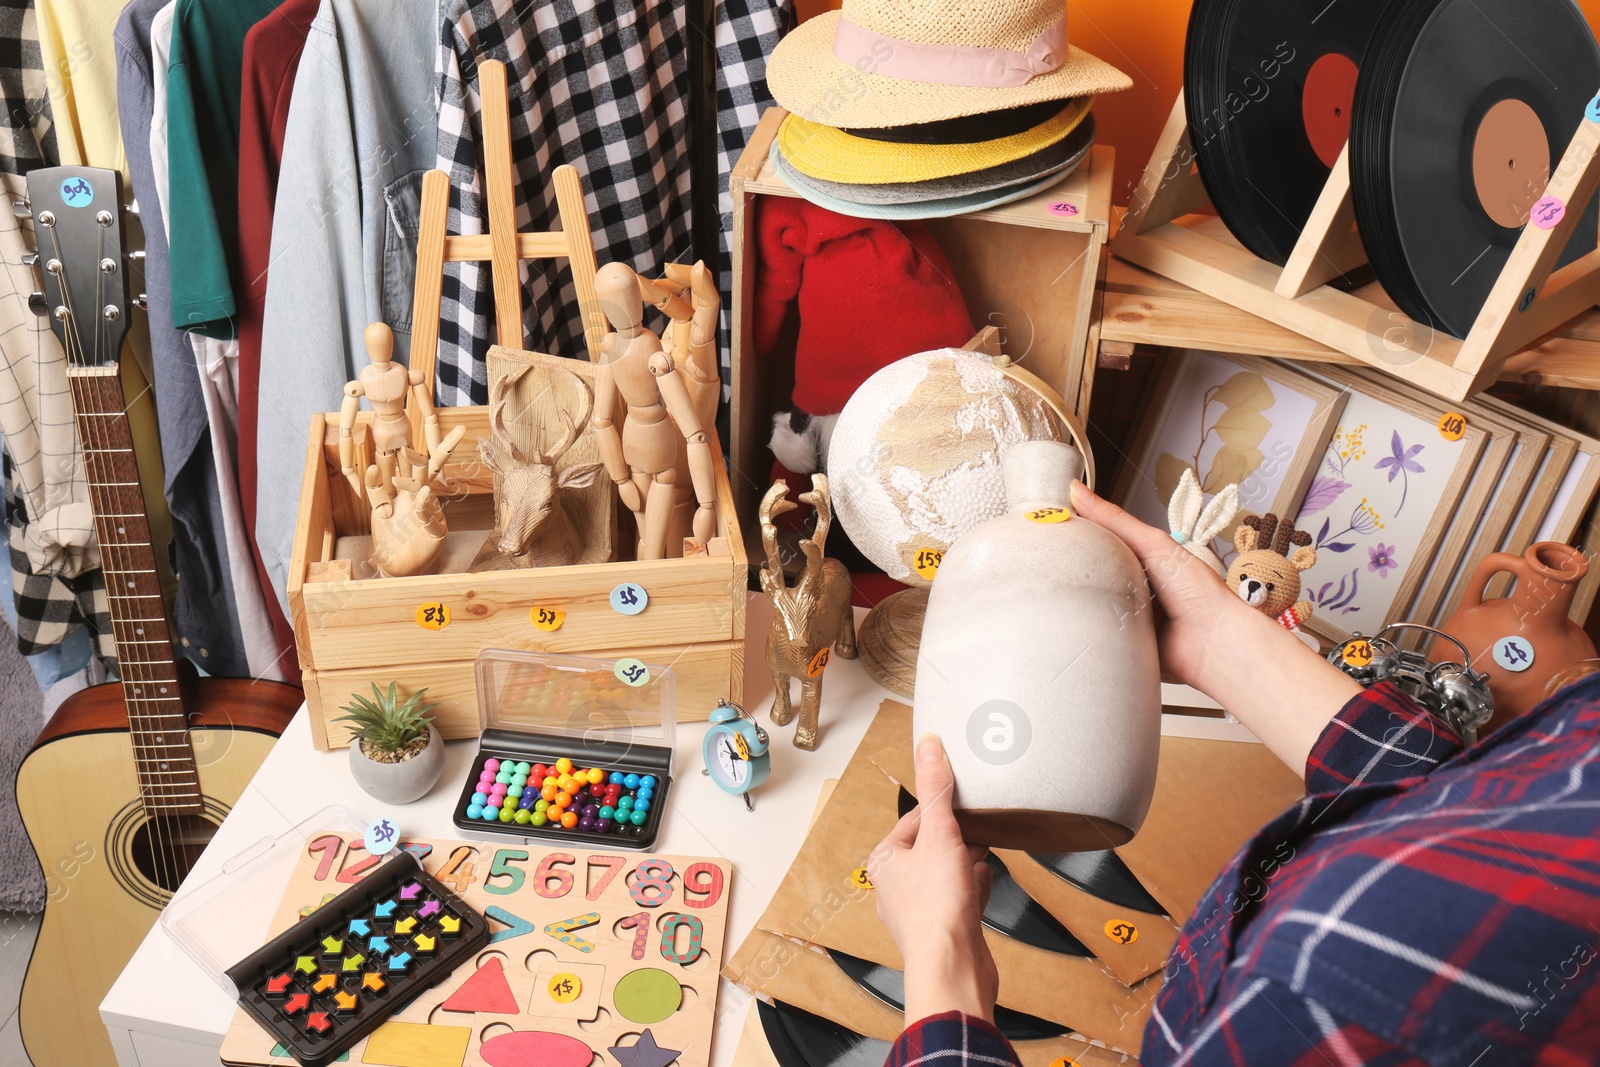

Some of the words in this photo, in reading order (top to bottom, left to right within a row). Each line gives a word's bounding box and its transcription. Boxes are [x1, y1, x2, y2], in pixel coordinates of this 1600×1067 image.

[1538, 202, 1562, 223] 1$
[423, 603, 446, 626] 8$
[373, 819, 395, 843] 3$
[435, 846, 478, 892] 4
[483, 848, 529, 895] 5
[533, 852, 576, 898] 6
[586, 854, 627, 902] 7
[629, 857, 675, 907] 8
[683, 862, 724, 909] 9
[617, 912, 705, 964] 10
[553, 978, 574, 997] 1$
